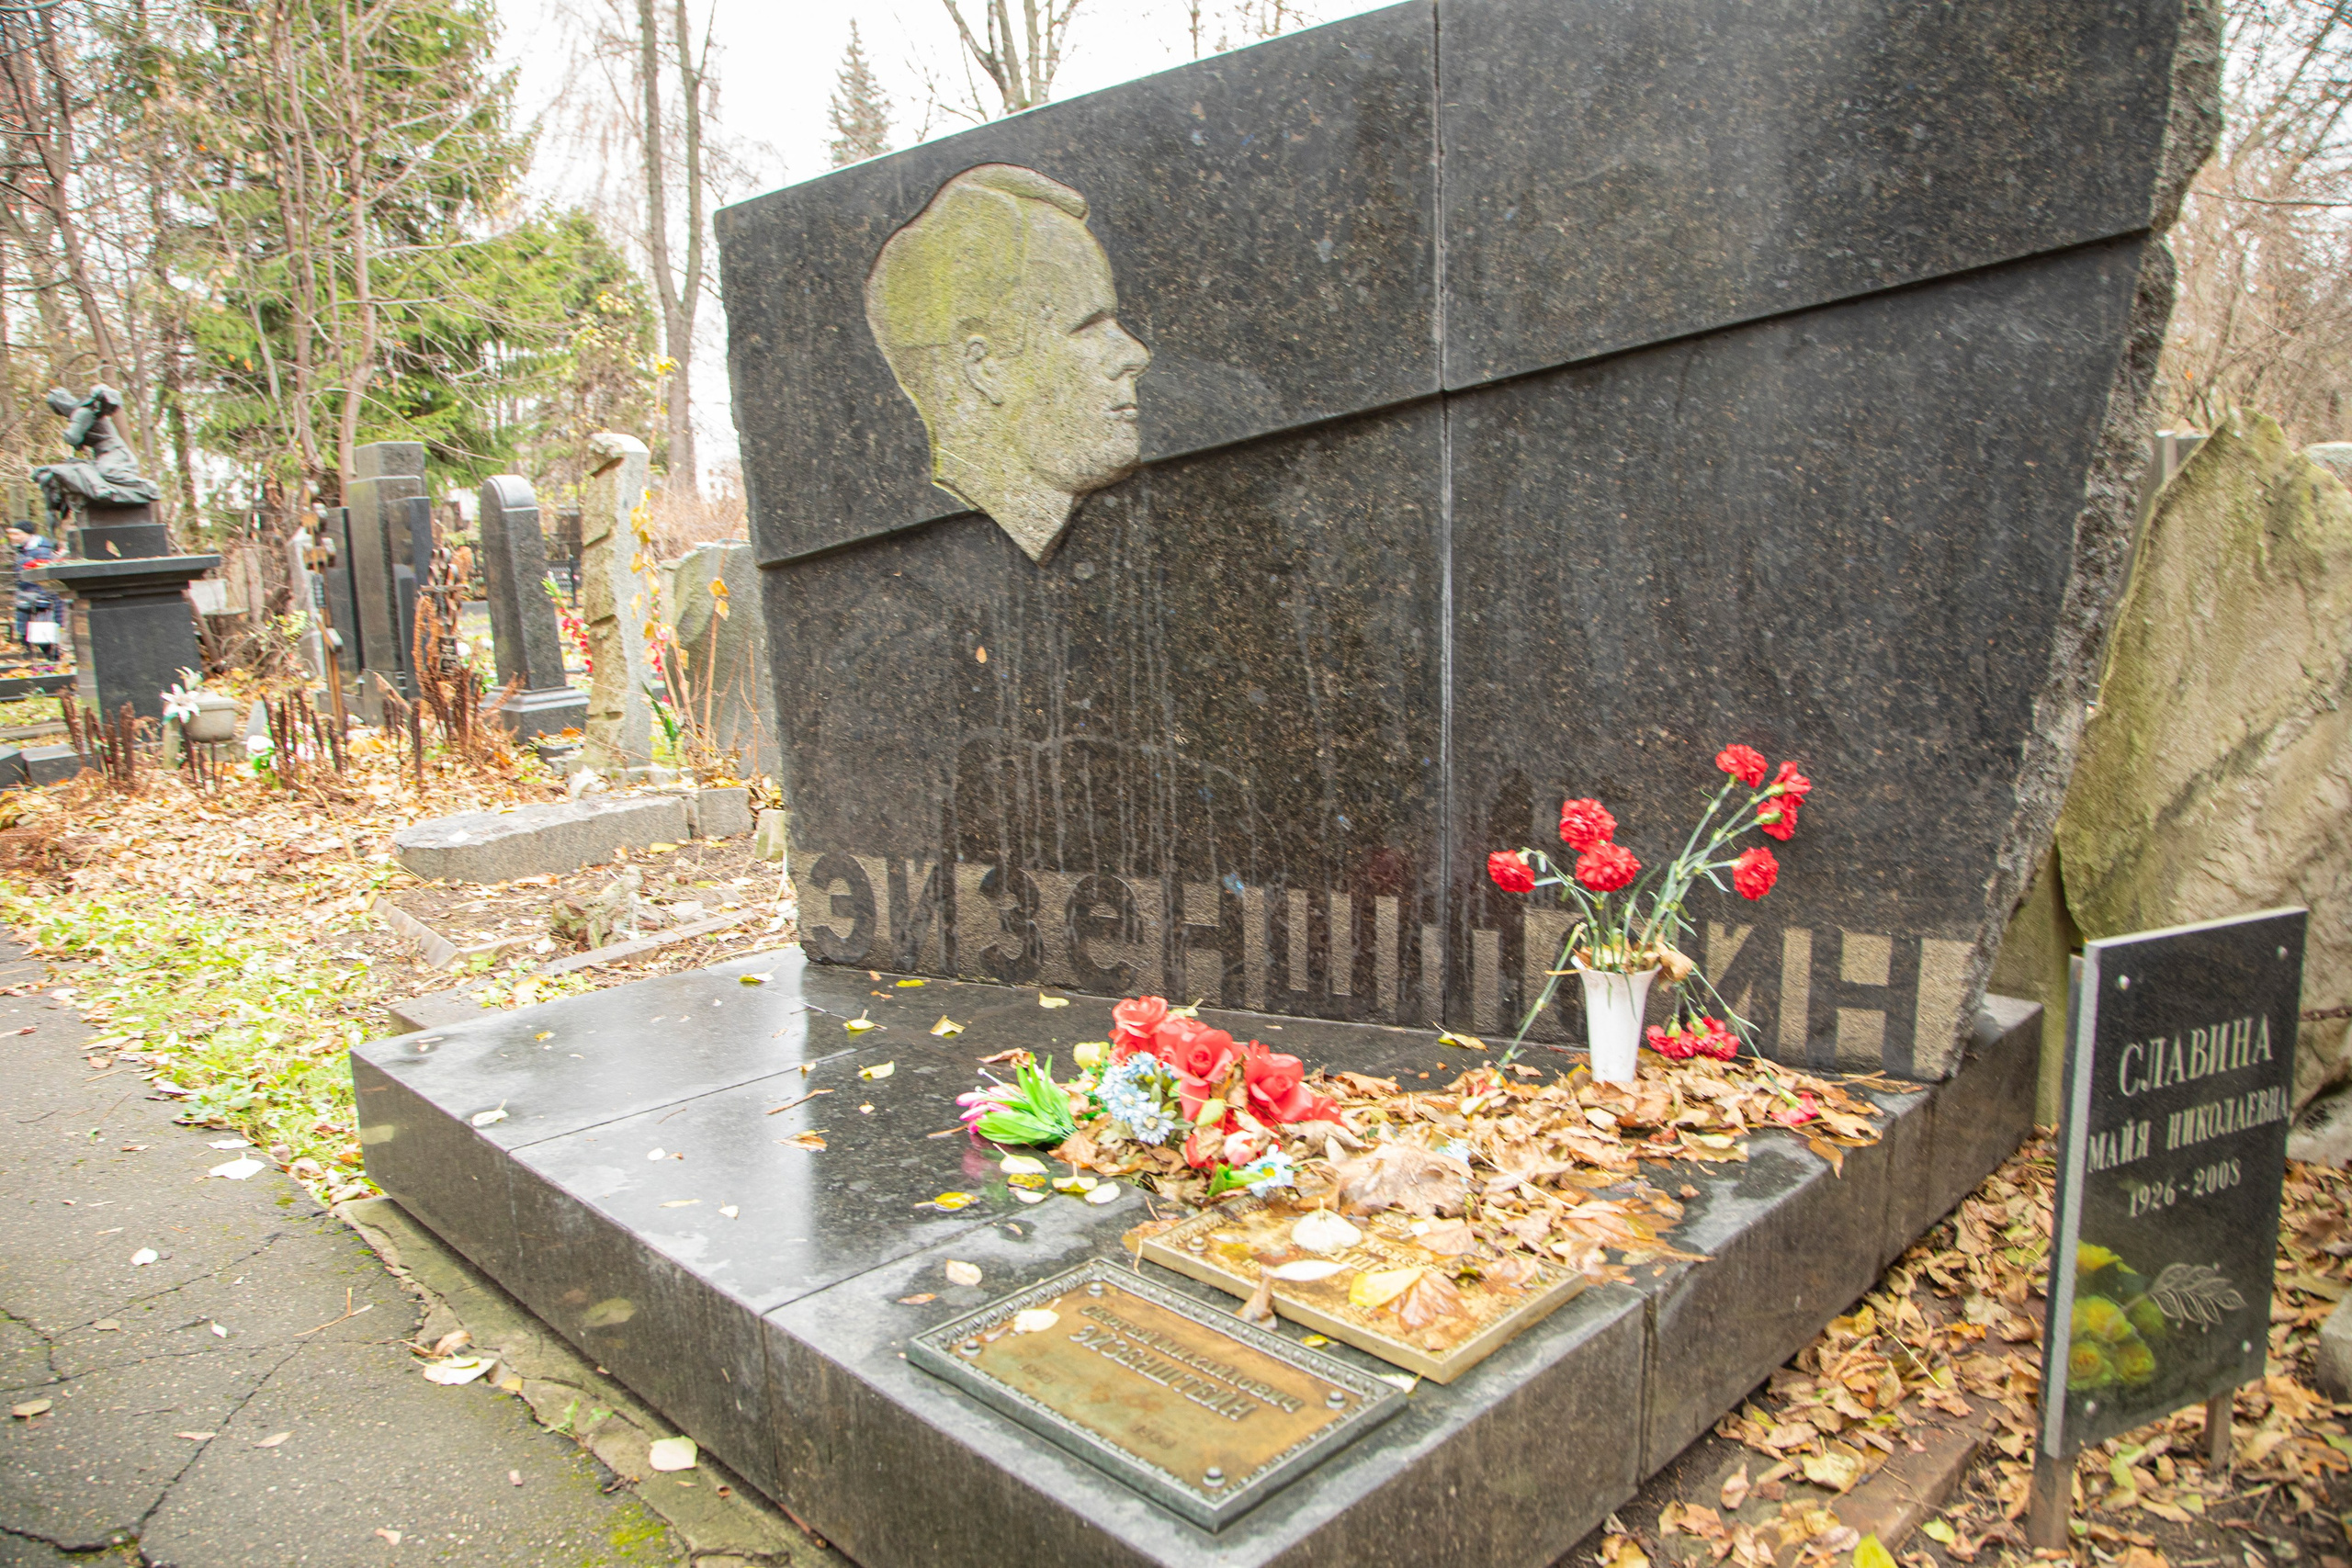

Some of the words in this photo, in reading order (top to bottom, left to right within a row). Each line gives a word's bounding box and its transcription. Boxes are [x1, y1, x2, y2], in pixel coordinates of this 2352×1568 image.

[2119, 1013, 2274, 1097] СЛАВИНА
[2086, 1118, 2152, 1174] МАЙЯ
[2166, 1085, 2290, 1151] НИКОЛАЕВНА
[1069, 1325, 1258, 1422] ЭЙЗЕНШТЕЙН
[1080, 1304, 1159, 1346] СЕРГЕЙ
[1153, 1338, 1306, 1414] МИХАЙЛОВИЧ
